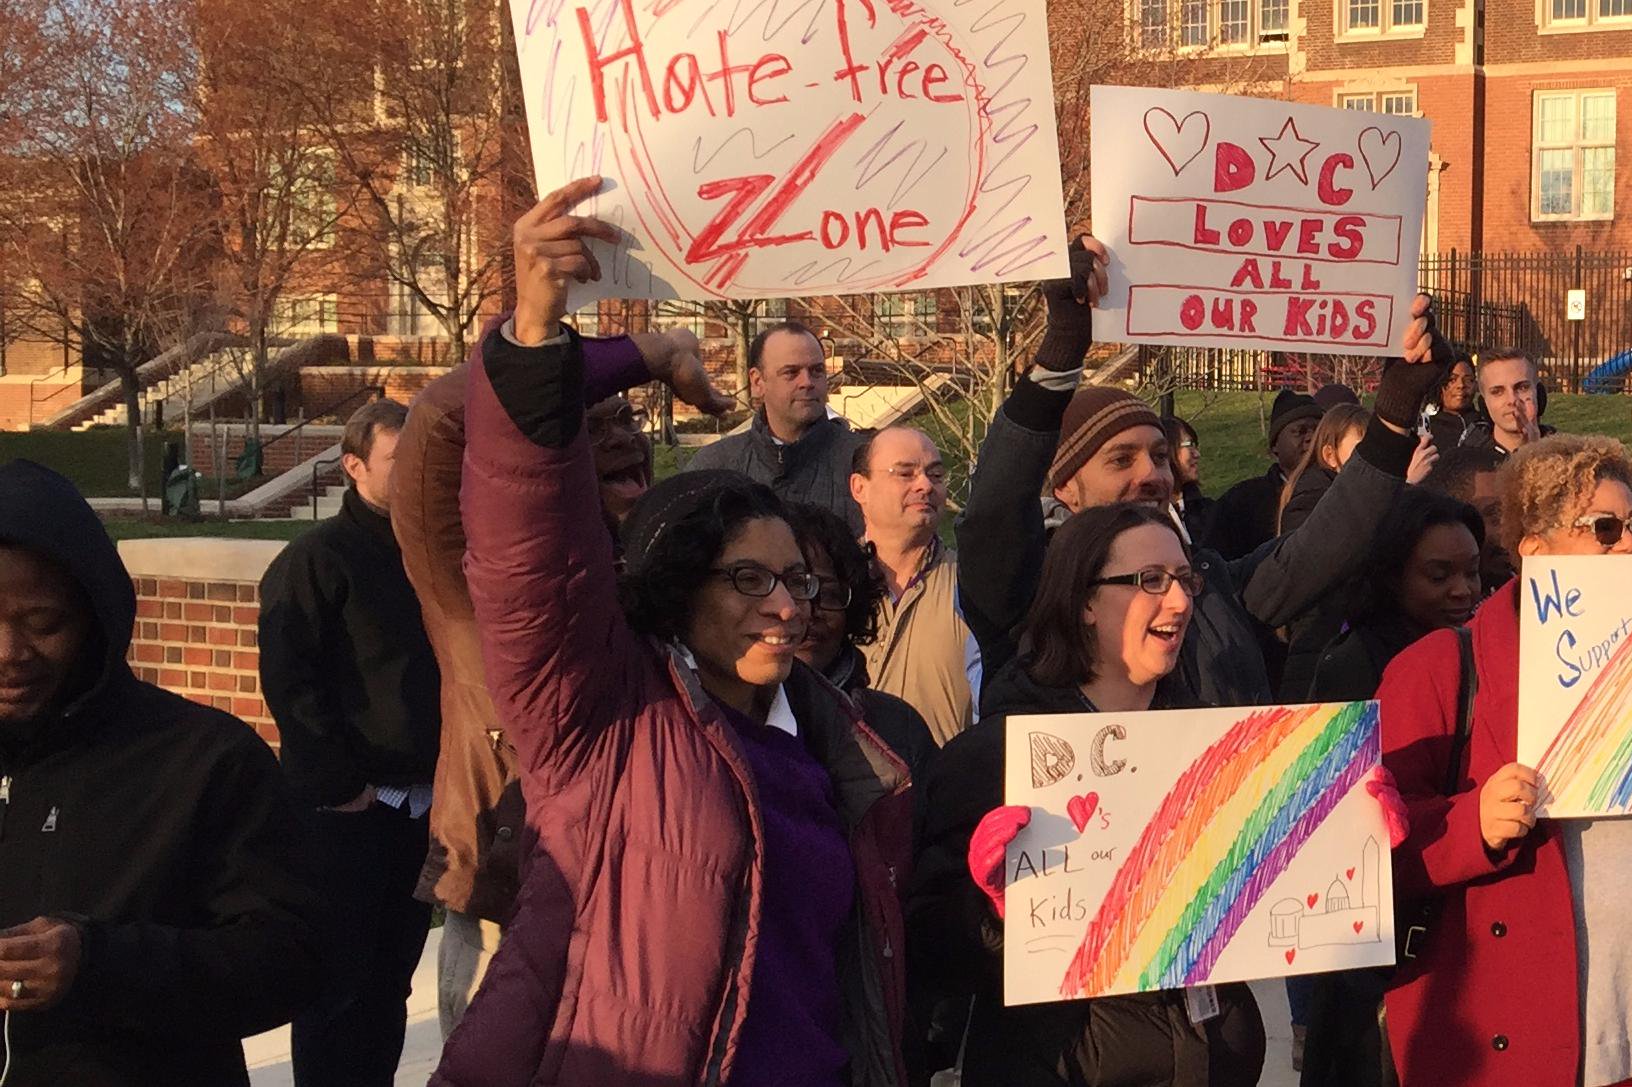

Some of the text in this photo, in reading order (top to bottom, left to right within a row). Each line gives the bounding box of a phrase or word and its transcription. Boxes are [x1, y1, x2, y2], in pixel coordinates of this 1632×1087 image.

[1194, 203, 1367, 260] LOVES
[1230, 258, 1321, 291] ALL
[1530, 568, 1586, 625] We
[1028, 723, 1138, 790] D.C.
[1014, 845, 1118, 882] ALL our
[1029, 887, 1087, 928] Kids
